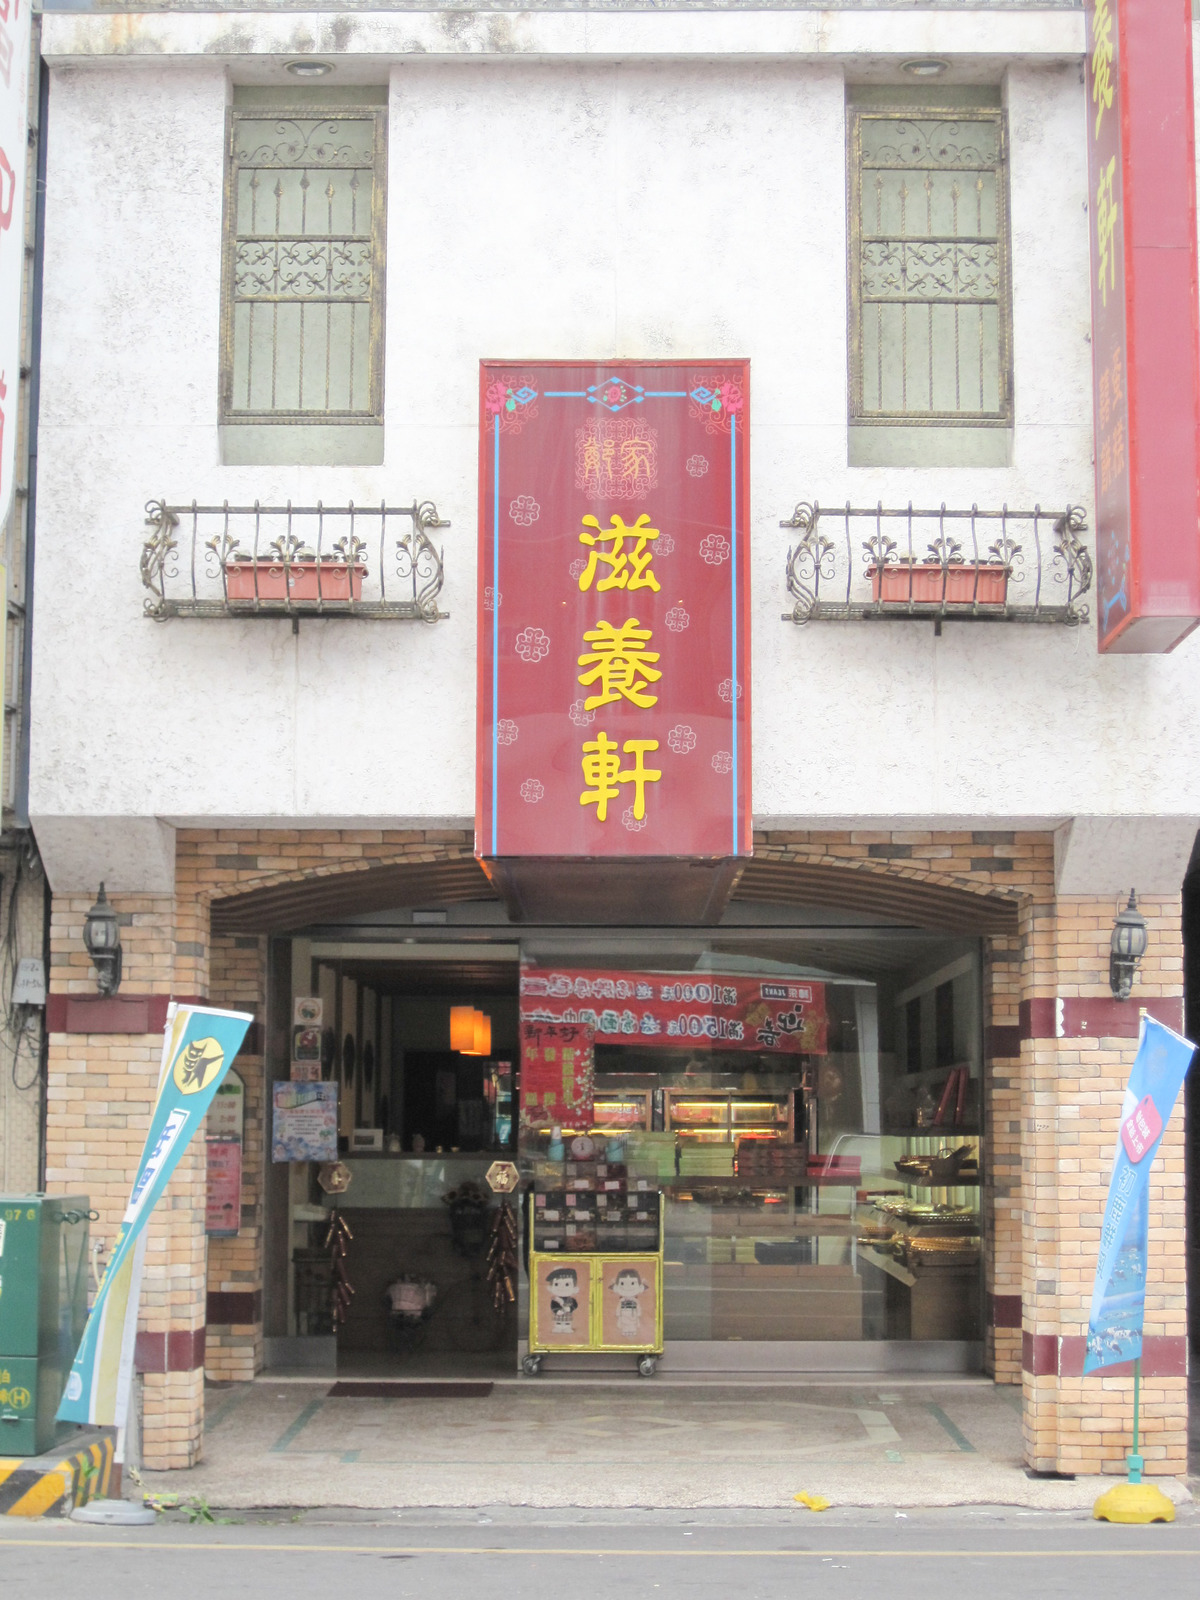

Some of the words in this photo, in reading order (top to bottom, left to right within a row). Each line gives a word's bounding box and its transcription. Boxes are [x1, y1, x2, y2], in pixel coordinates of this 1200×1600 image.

[578, 513, 662, 822] 滋養軒
[524, 1025, 579, 1046] 新年好
